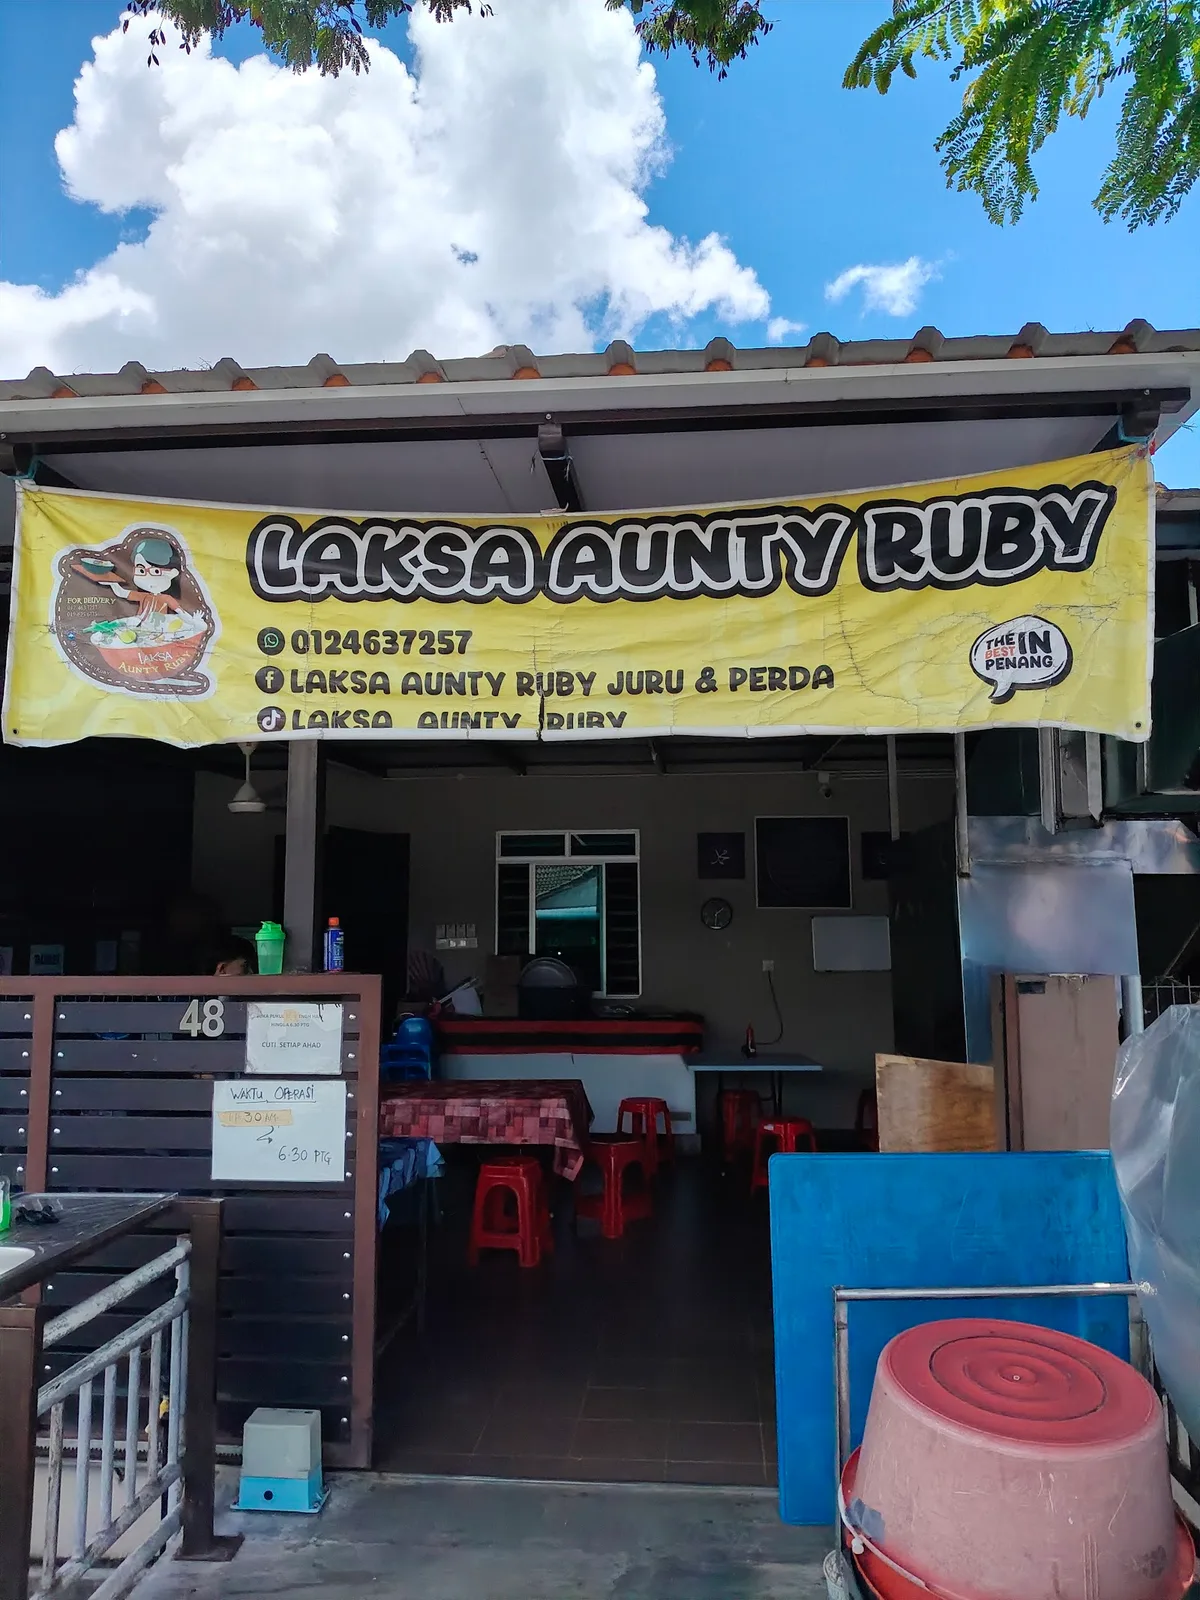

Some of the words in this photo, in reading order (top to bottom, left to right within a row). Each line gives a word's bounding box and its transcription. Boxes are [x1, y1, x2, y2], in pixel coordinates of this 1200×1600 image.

[248, 516, 541, 603] LAKSA
[543, 506, 855, 603] AUNTY
[858, 481, 1115, 592] RUBY
[83, 596, 116, 605] DELIVERY
[290, 629, 472, 656] 0124637257
[986, 633, 1015, 650] THE
[1018, 630, 1052, 655] IN
[137, 650, 173, 665] LAKSA
[985, 646, 1015, 660] BEST
[118, 661, 159, 674] AUNTY
[164, 650, 192, 672] RUBY
[985, 655, 1053, 671] PENANG
[290, 668, 391, 695] LAKSA
[401, 671, 506, 697] AUNTY
[516, 671, 597, 698] RUBY
[607, 669, 684, 695] JURU
[695, 666, 719, 693] &
[729, 664, 834, 693] PERDA
[292, 709, 393, 729] LAKSA
[179, 999, 225, 1037] 48
[261, 1041, 277, 1049] CUTI
[279, 1041, 301, 1049] SETIAP
[302, 1041, 321, 1049] AHAD
[273, 1084, 315, 1101] OPERASI
[314, 1149, 332, 1166] PTG
